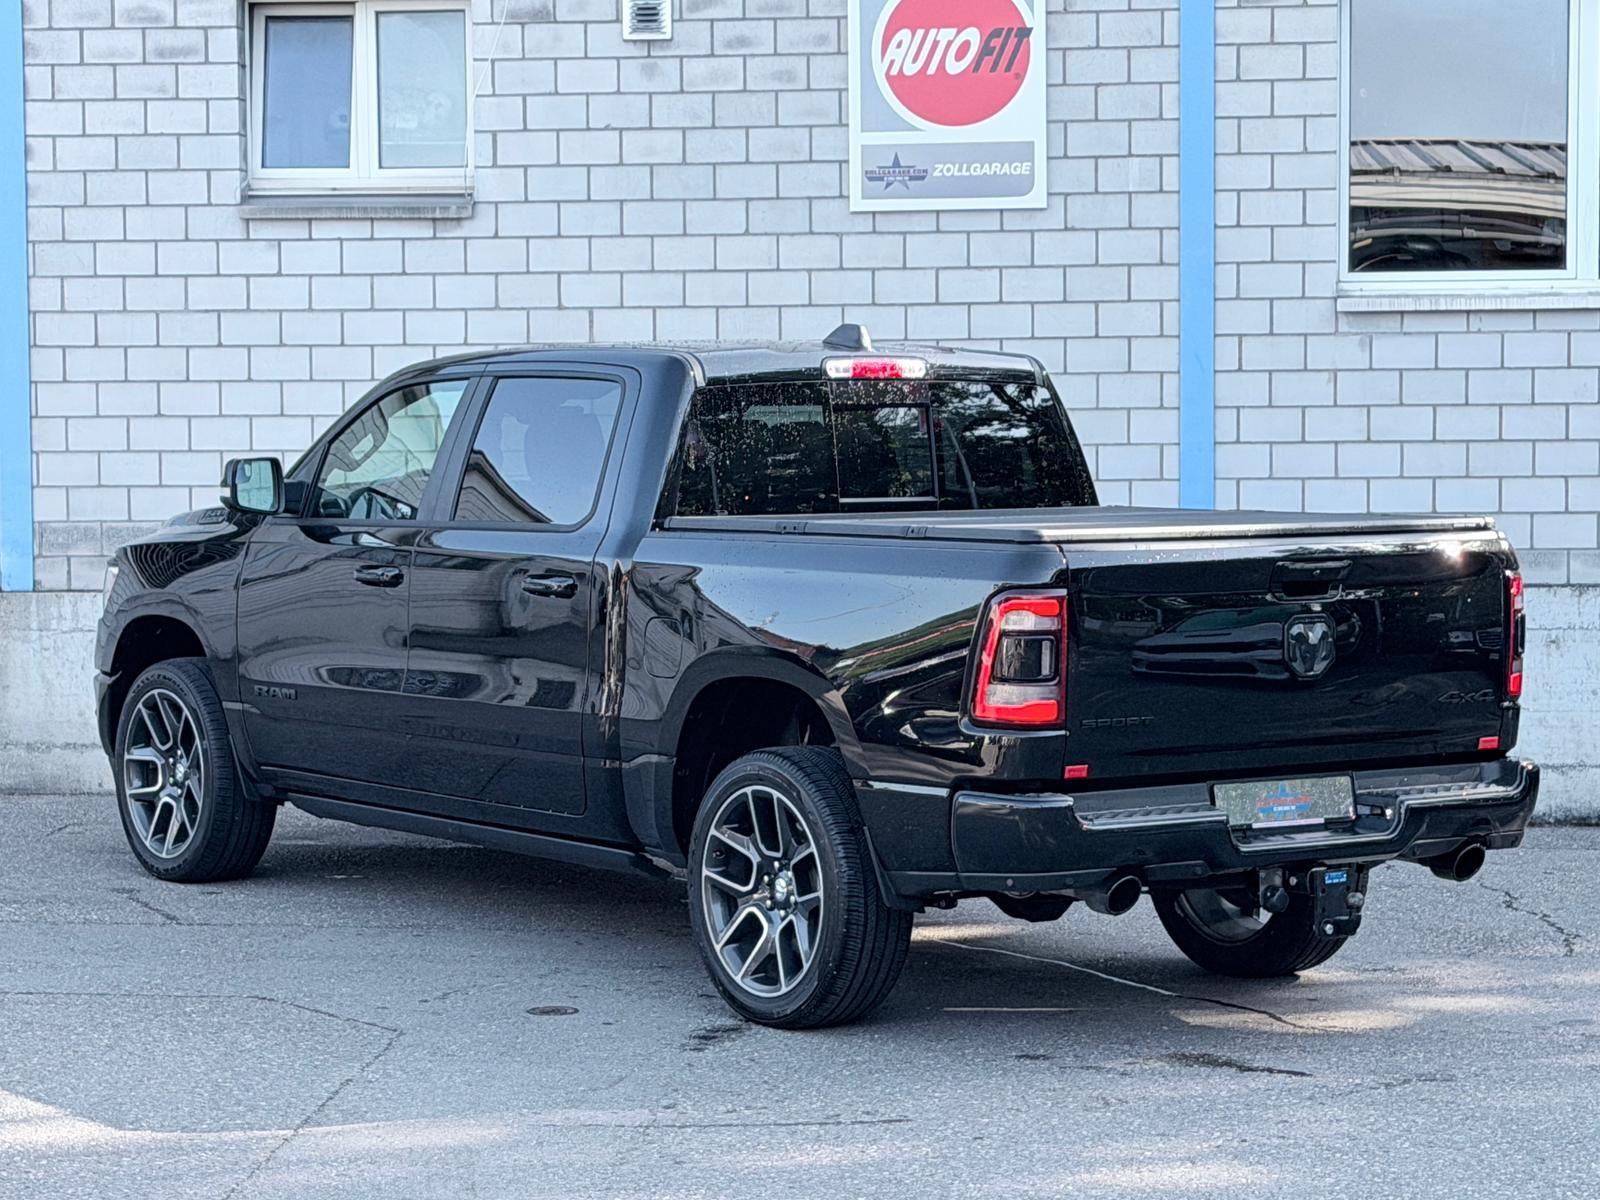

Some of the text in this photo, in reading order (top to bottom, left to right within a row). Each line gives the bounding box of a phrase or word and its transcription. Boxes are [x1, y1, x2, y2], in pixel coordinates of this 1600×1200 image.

[882, 27, 1034, 76] AUTOFIT
[933, 162, 1032, 177] ZOLLGARAGE
[254, 685, 298, 700] RAM
[1081, 716, 1155, 729] SPORT
